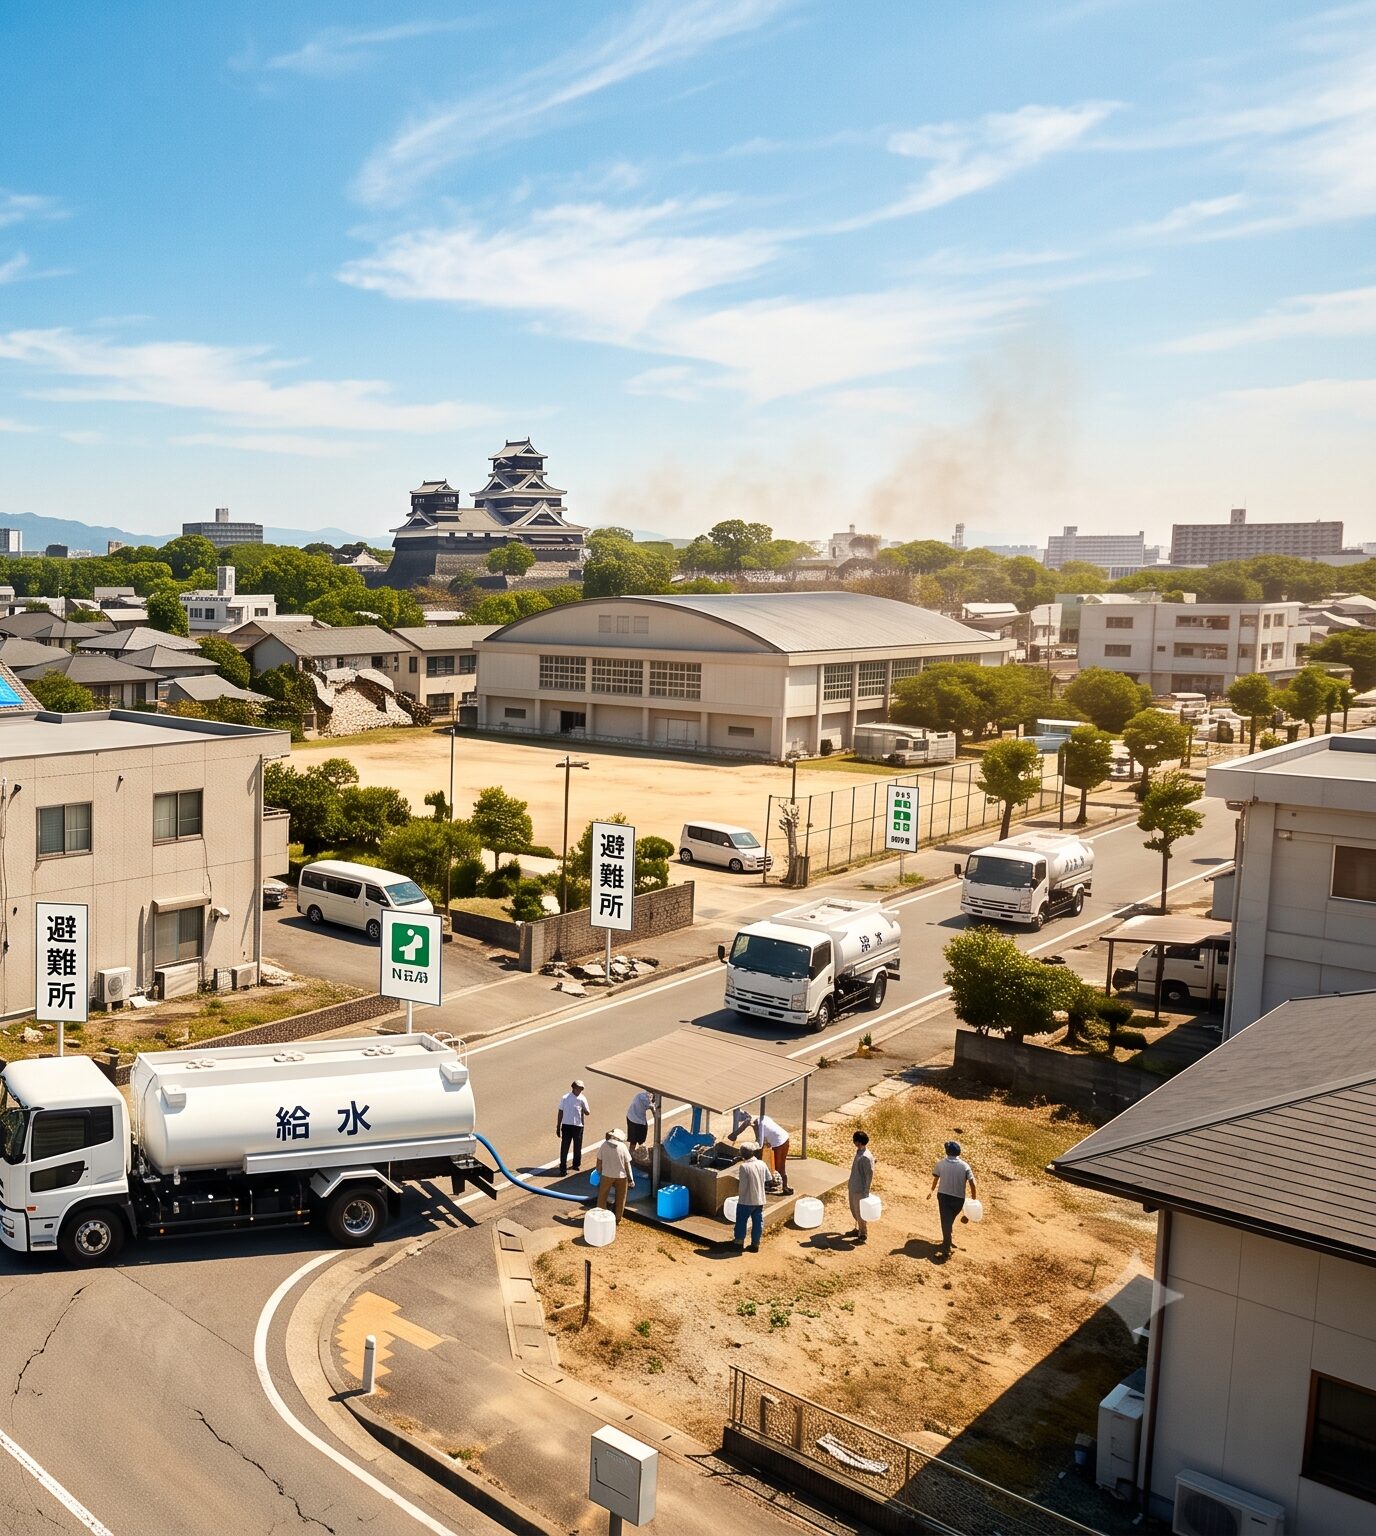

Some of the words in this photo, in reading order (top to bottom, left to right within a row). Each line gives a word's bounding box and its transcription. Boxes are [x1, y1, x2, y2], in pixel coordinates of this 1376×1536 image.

[600, 833, 625, 919] 避難所
[47, 915, 77, 1010] 避難所
[275, 1100, 372, 1142] 給水
